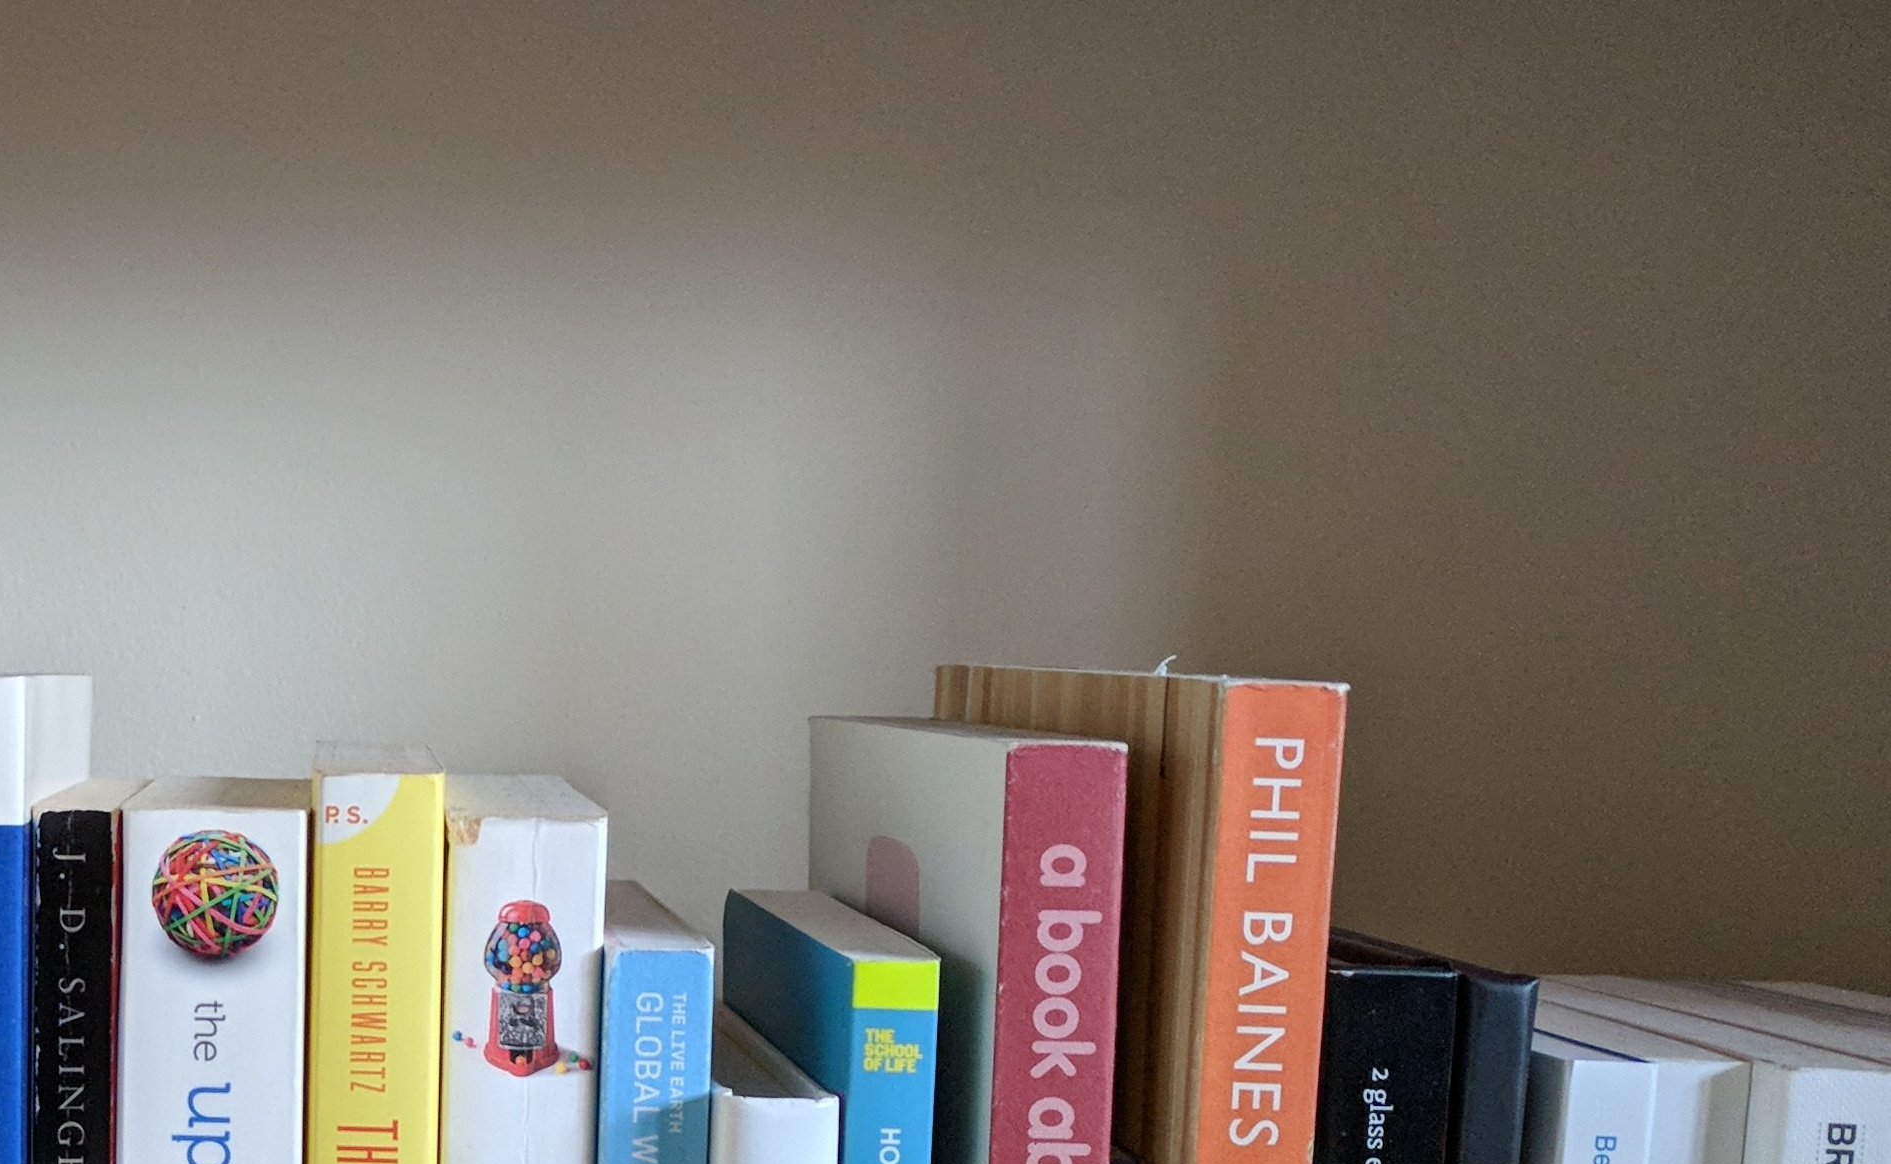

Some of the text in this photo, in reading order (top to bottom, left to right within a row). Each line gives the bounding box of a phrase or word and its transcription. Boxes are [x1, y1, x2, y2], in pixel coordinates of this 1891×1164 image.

[1245, 737, 1306, 884] PHIL
[350, 867, 390, 1095] BARRY SCHWARTZ
[1029, 909, 1103, 1079] book
[1228, 911, 1295, 1149] BAINES
[632, 990, 664, 1124] GLOBAL
[668, 1030, 686, 1133] LIVE EARTH
[1362, 1089, 1394, 1150] glass
